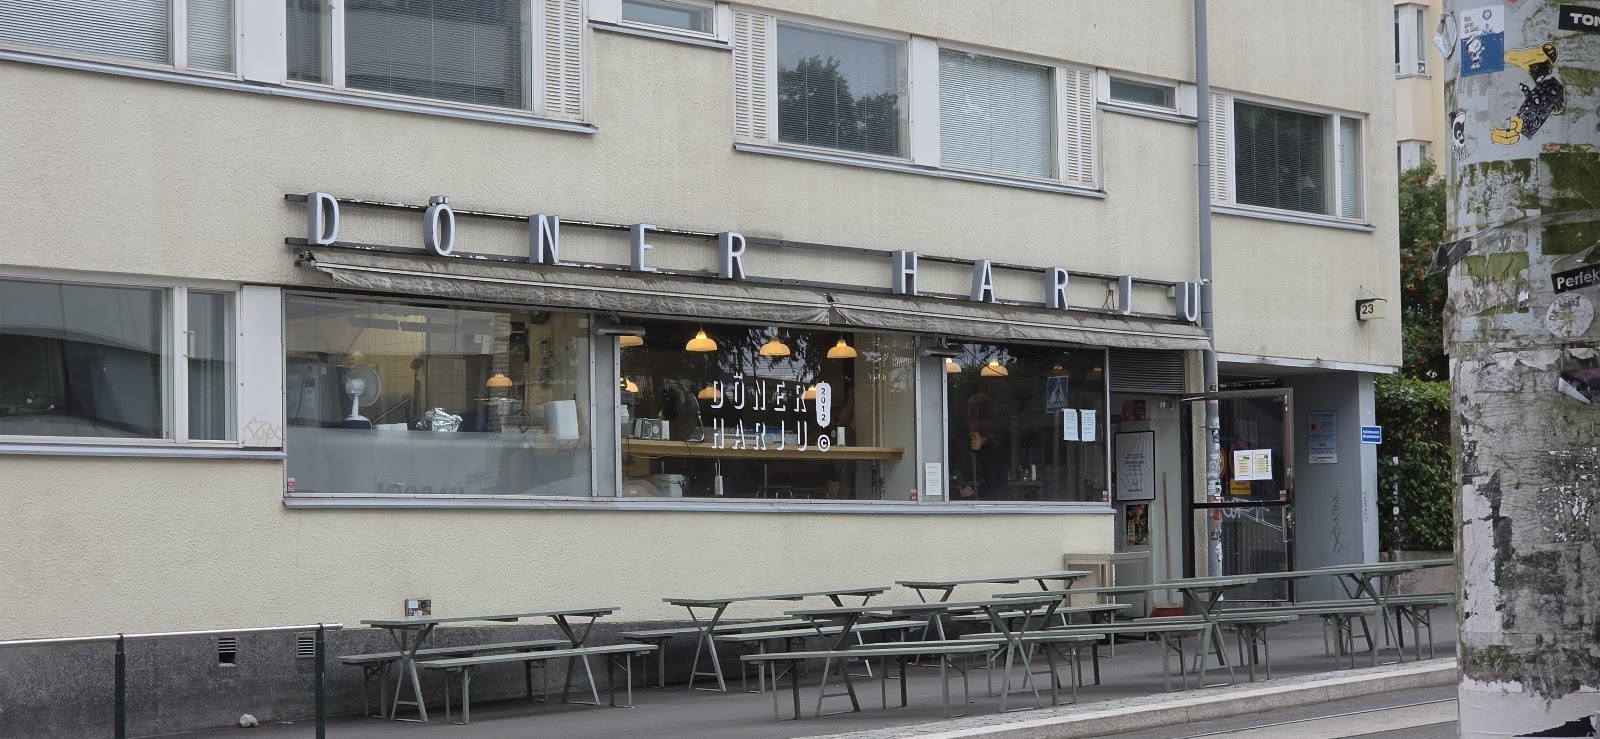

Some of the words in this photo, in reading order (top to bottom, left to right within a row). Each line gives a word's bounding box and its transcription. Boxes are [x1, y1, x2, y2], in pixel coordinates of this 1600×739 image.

[307, 192, 747, 279] DÖNER
[892, 250, 1200, 322] HARJU
[1361, 303, 1374, 315] 23
[711, 372, 807, 412] DÖNER
[711, 418, 808, 452] HARJU
